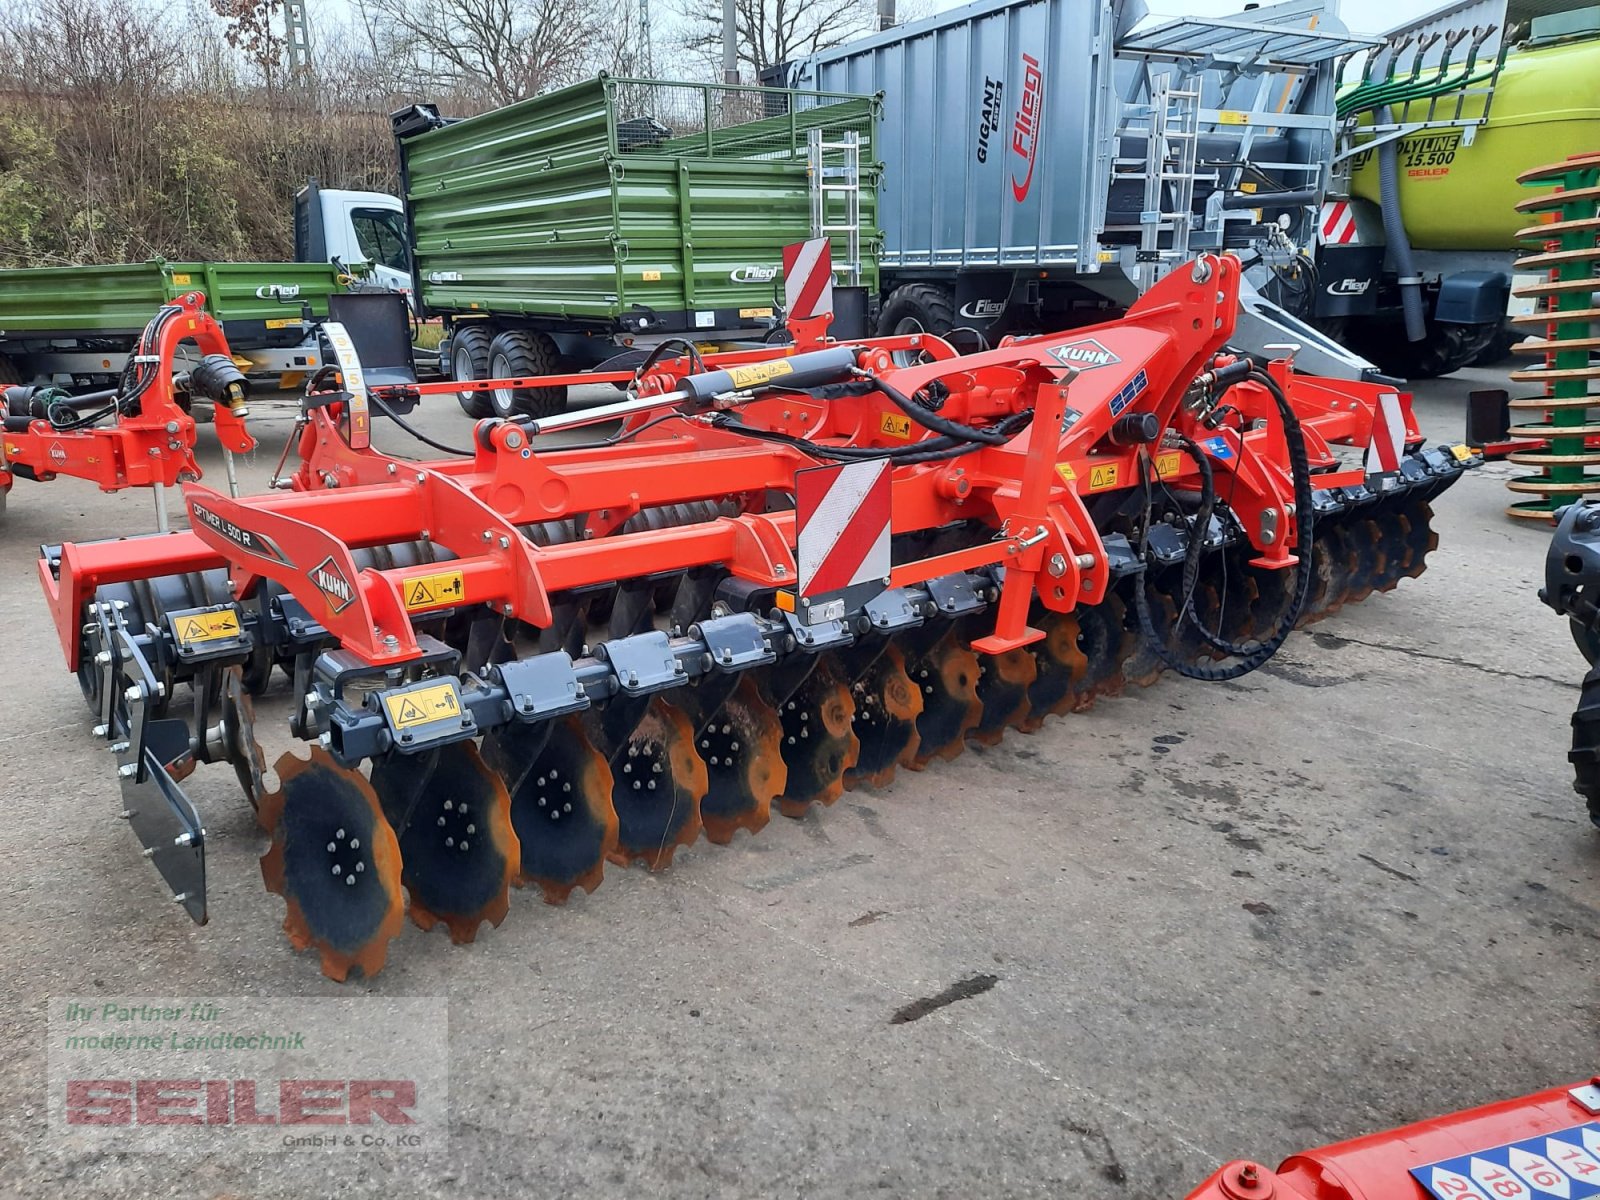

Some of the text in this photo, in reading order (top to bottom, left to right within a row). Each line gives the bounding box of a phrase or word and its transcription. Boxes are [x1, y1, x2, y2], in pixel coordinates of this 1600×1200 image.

[1012, 52, 1041, 159] Fliegl
[977, 75, 996, 164] GIGANT
[1396, 134, 1461, 154] OLYLINE
[1404, 151, 1456, 167] 15.500
[1408, 167, 1450, 177] SEILER
[744, 265, 778, 280] Fliegl
[1340, 277, 1371, 293] Fliegl
[975, 298, 1008, 314] Fliegl
[342, 353, 352, 365] 7
[1058, 345, 1109, 365] KUHN
[348, 373, 360, 385] 5
[356, 415, 364, 428] 1
[193, 503, 252, 547] OPTIMER L 500 R
[318, 569, 350, 601] KUHN
[1561, 1148, 1599, 1176] 14
[1483, 1168, 1523, 1198] 18
[1523, 1159, 1562, 1187] 16
